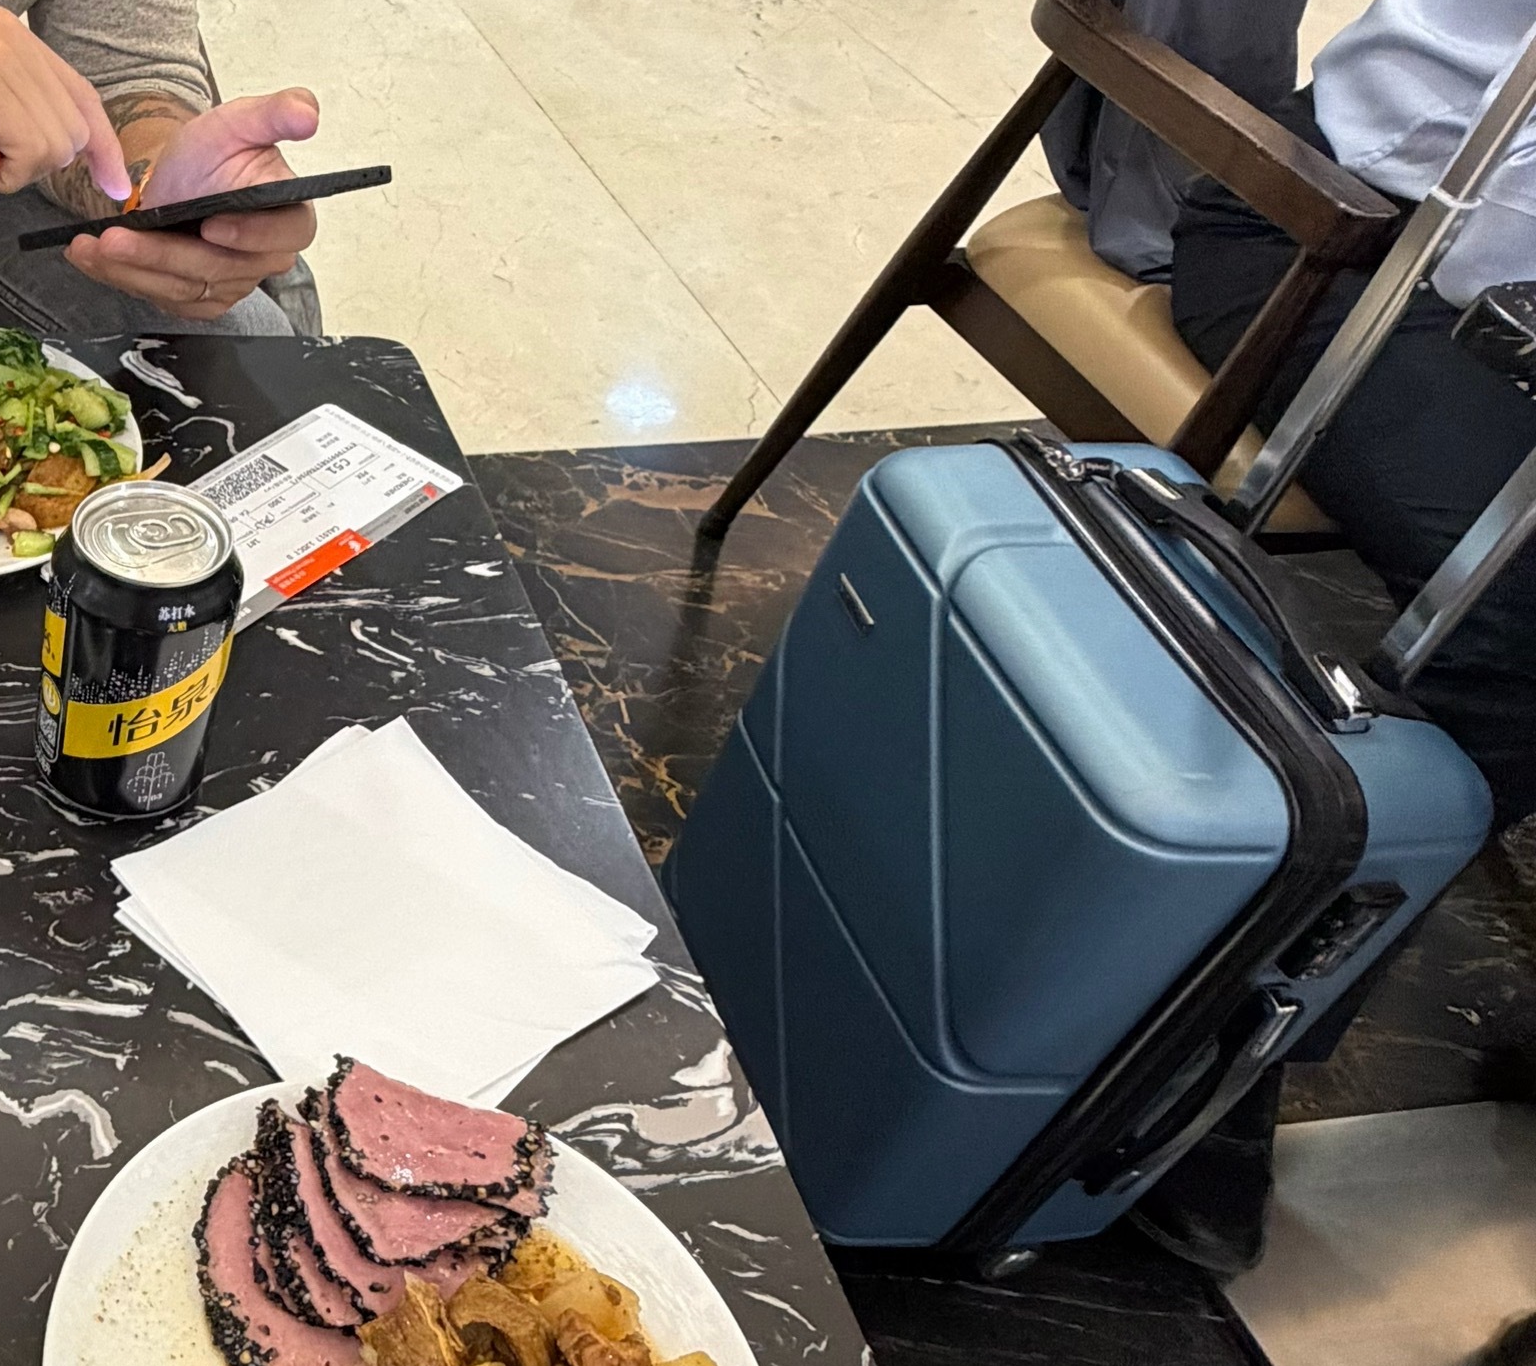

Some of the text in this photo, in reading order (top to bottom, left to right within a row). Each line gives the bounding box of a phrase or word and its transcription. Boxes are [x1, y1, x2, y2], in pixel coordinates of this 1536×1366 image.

[323, 457, 352, 475] C51
[158, 605, 196, 622] 苏打水
